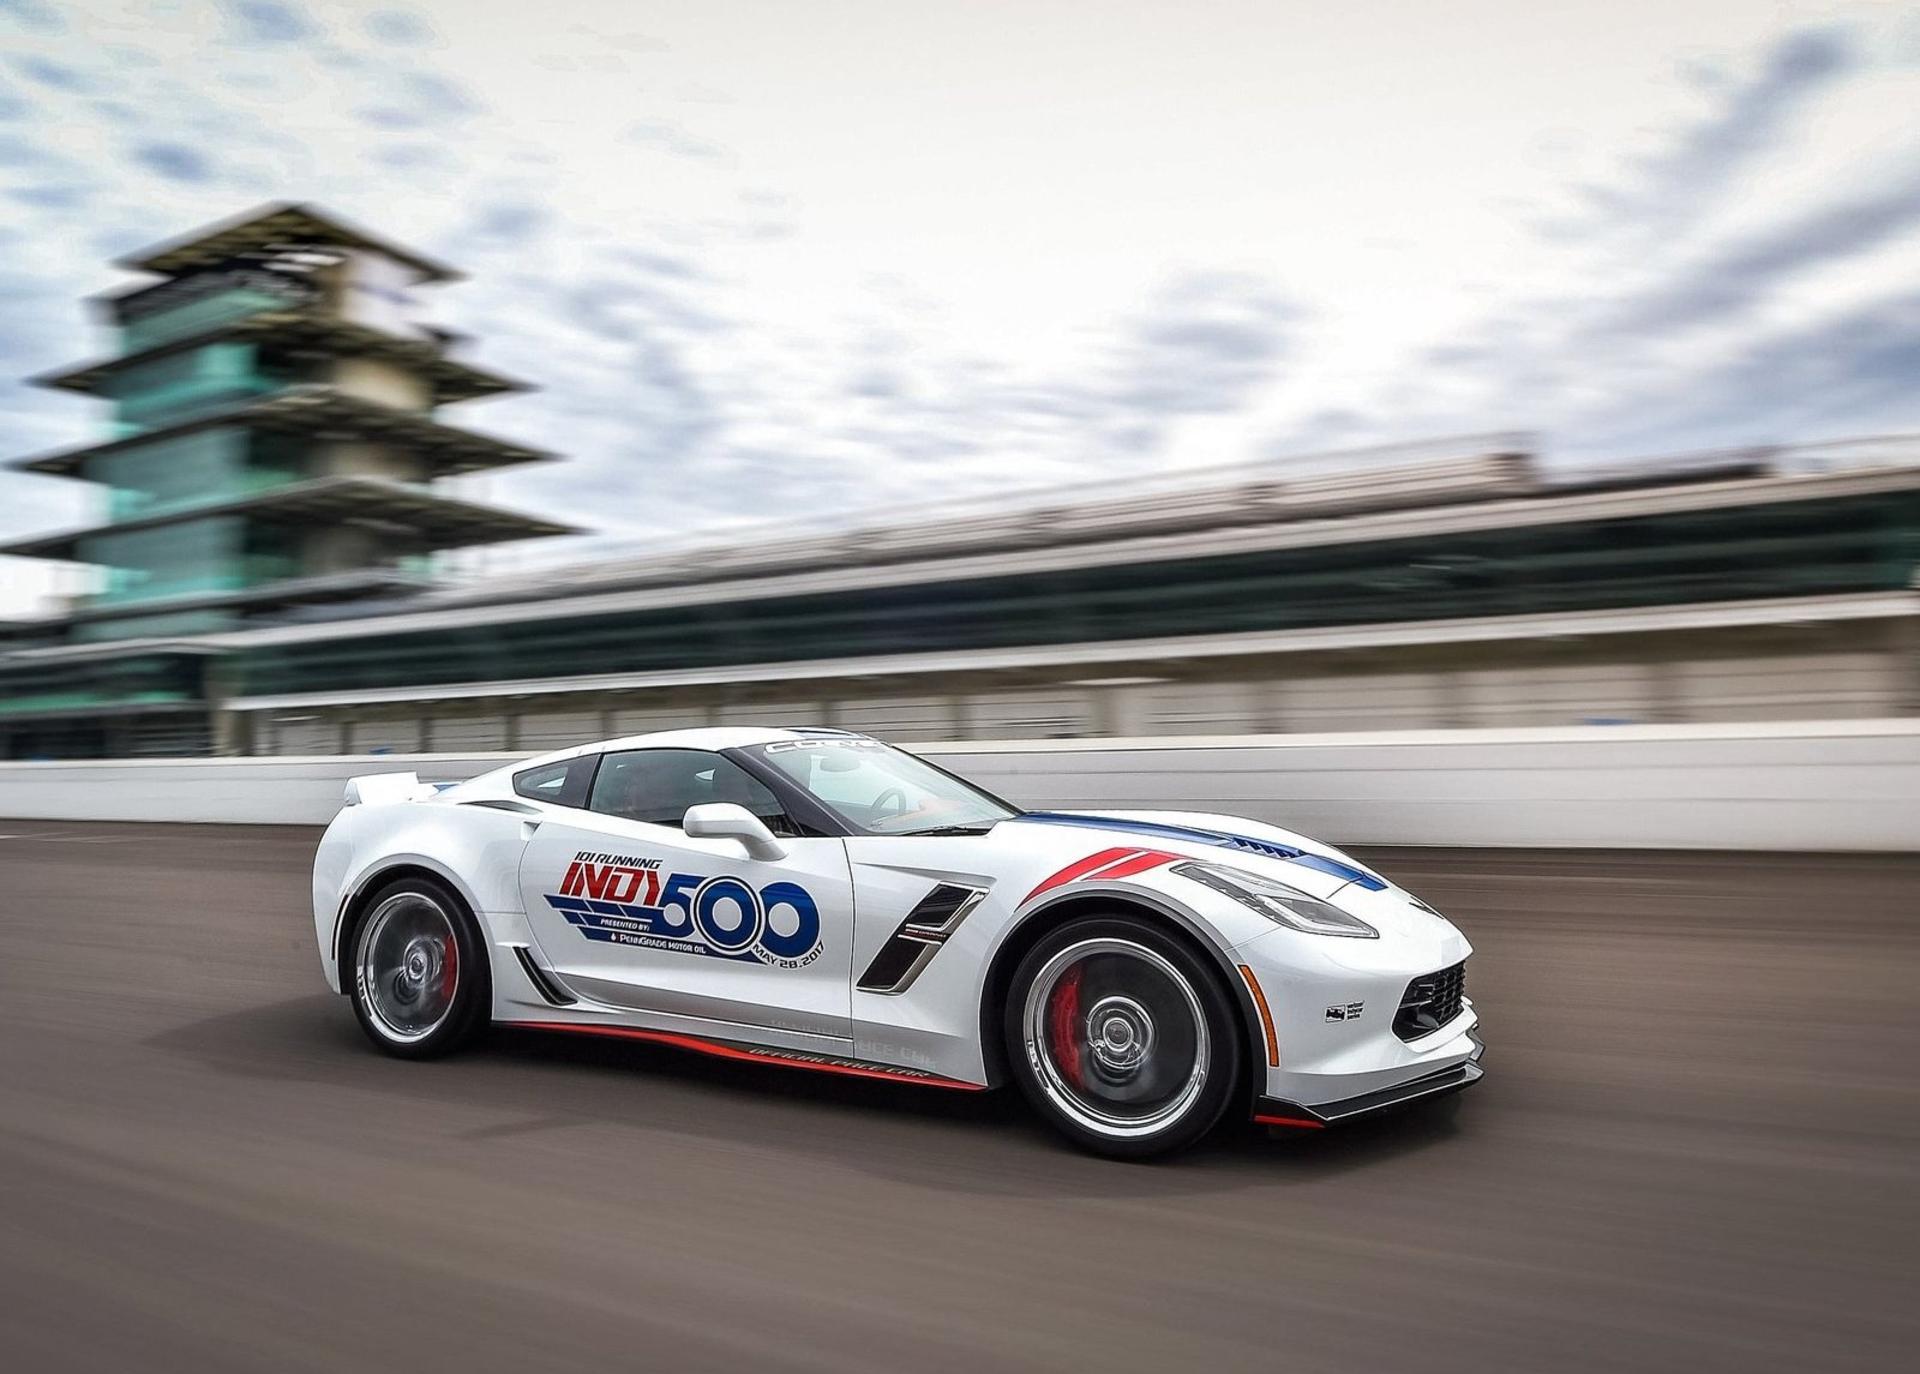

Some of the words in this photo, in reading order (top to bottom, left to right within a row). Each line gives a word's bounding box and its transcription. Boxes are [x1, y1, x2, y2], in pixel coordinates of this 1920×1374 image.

[574, 851, 597, 862] 101
[594, 853, 663, 869] RUNNING
[558, 861, 661, 907] INDY
[658, 872, 821, 959] 500
[600, 918, 638, 930] PRESENTED
[668, 942, 693, 953] MOTOR
[693, 946, 706, 955] OIL
[753, 944, 778, 965] MAY
